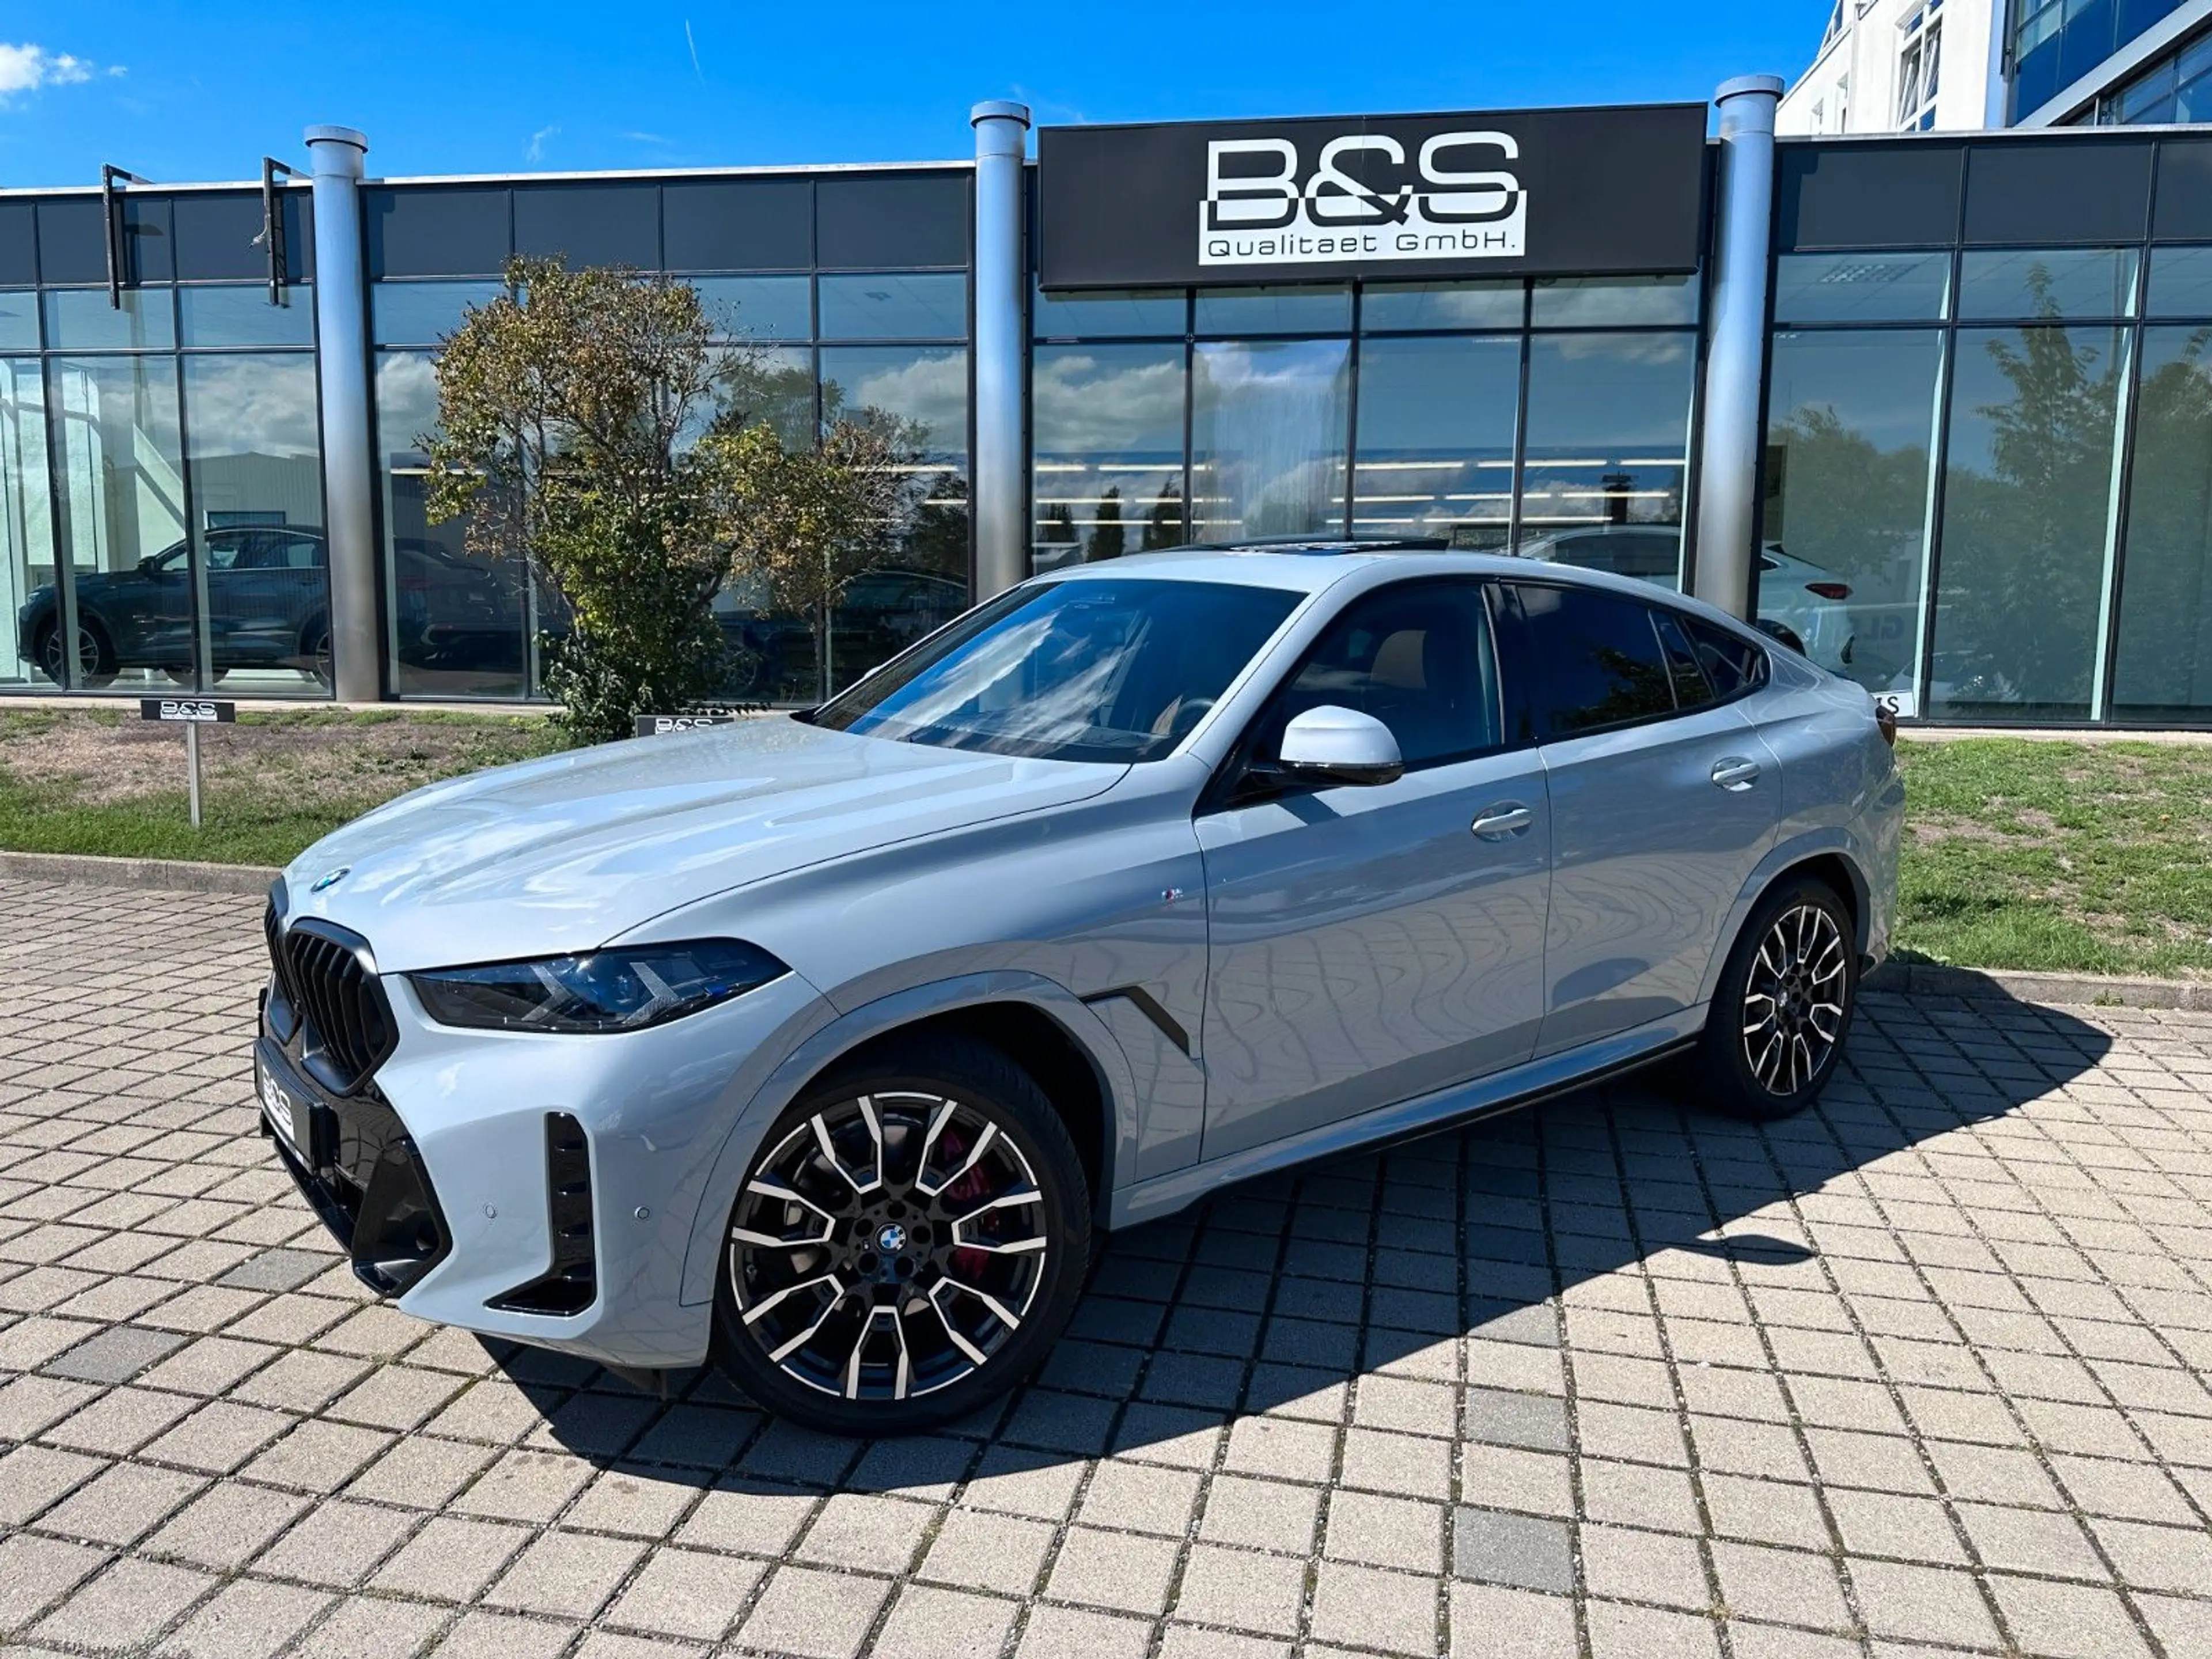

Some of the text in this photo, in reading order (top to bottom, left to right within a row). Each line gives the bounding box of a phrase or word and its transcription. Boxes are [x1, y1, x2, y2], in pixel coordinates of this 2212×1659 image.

[1207, 131, 1519, 232] B&S
[1208, 229, 1516, 257] Qualitaet GmbH.
[161, 700, 215, 715] B&S
